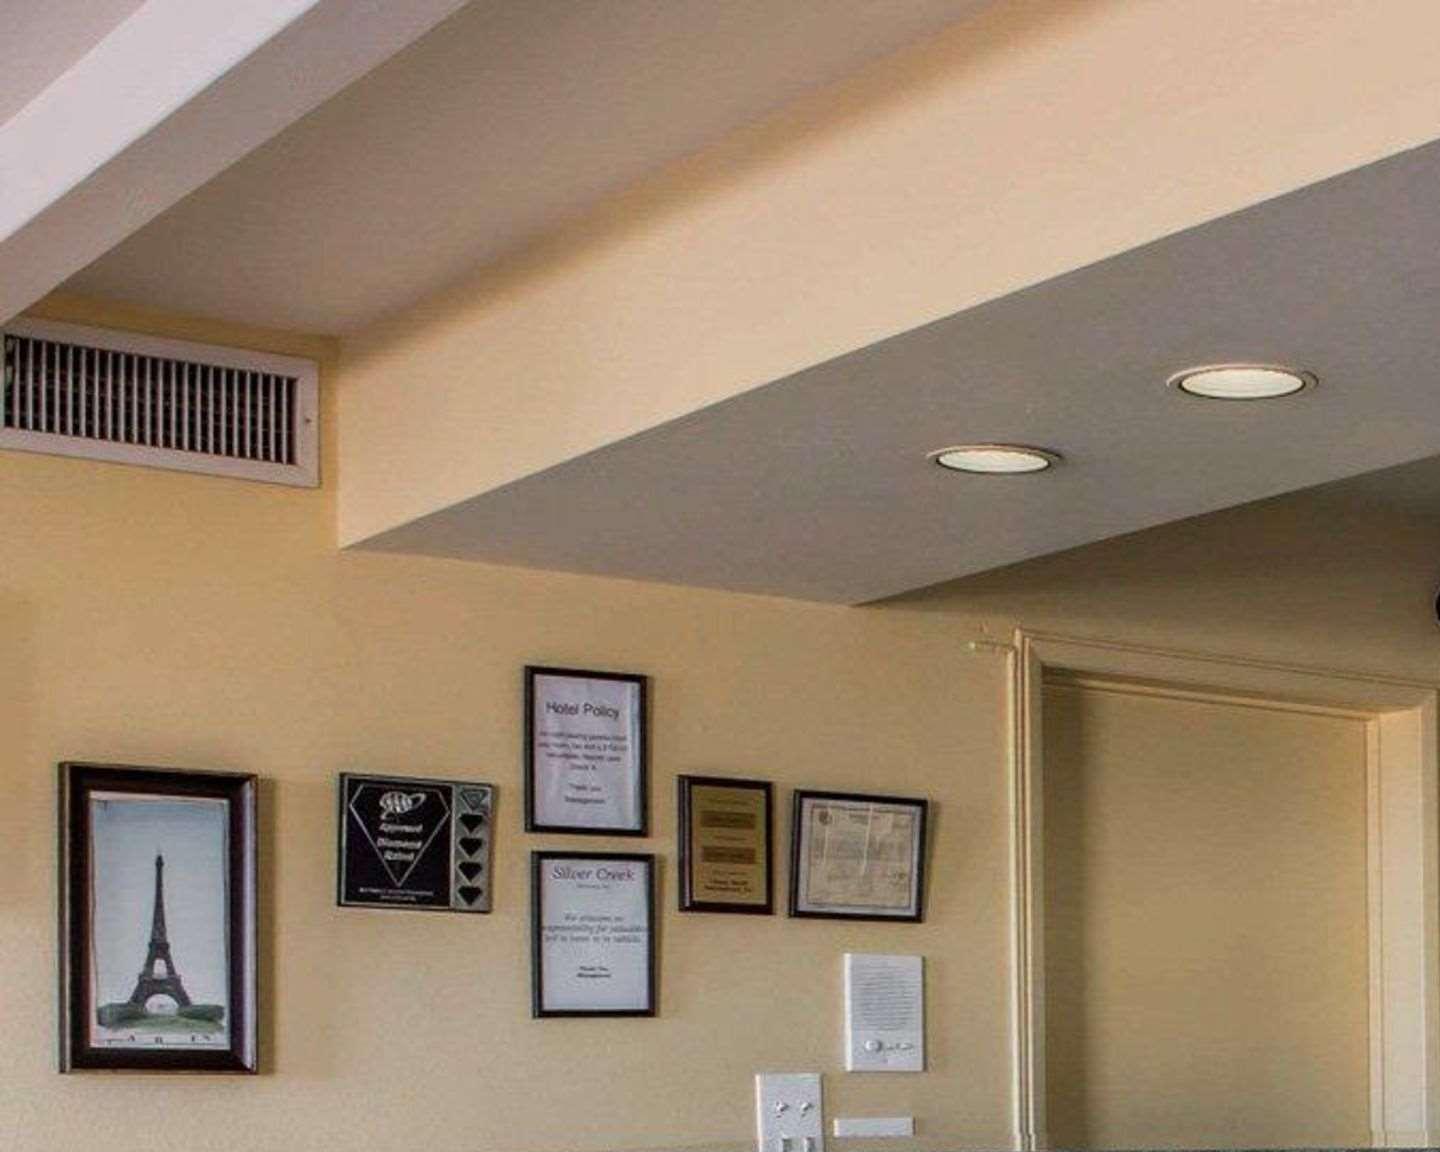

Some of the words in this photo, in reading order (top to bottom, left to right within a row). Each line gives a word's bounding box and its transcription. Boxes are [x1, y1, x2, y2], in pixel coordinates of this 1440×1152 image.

[546, 701, 579, 716] Hotel
[583, 702, 620, 721] Policy
[552, 865, 593, 880] Silver
[596, 867, 634, 881] Creek
